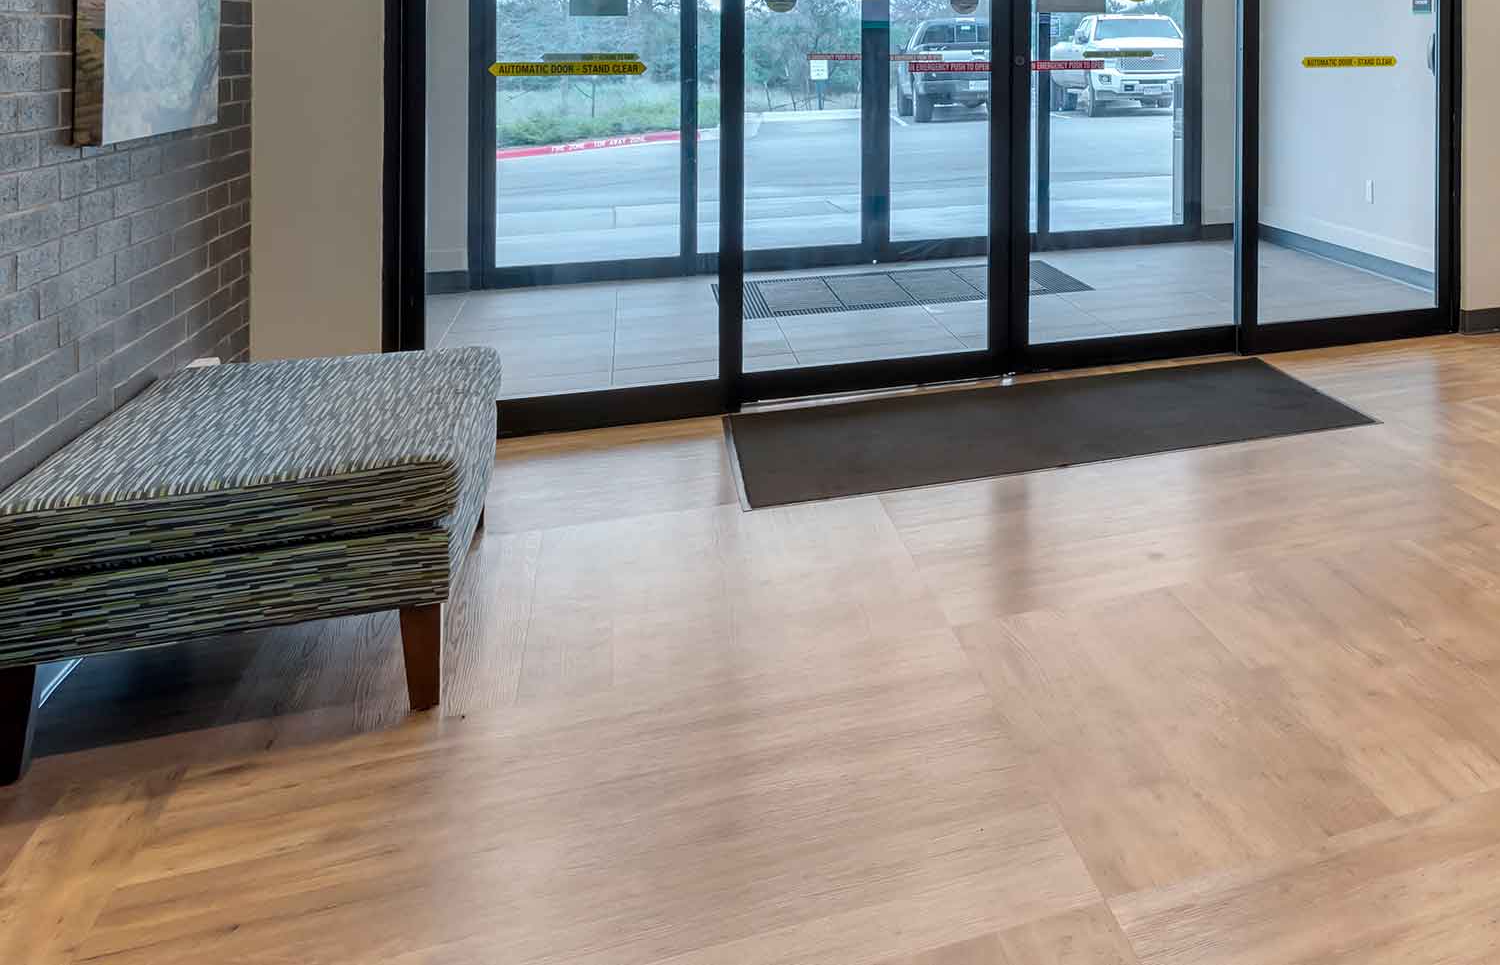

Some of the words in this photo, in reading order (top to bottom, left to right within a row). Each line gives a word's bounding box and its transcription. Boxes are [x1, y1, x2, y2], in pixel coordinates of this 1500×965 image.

[1307, 58, 1337, 67] AUTOMATIC
[499, 64, 549, 76] AUTOMATIC
[551, 64, 574, 75] DOOR
[582, 64, 610, 74] STAND
[612, 63, 639, 73] CLEAR
